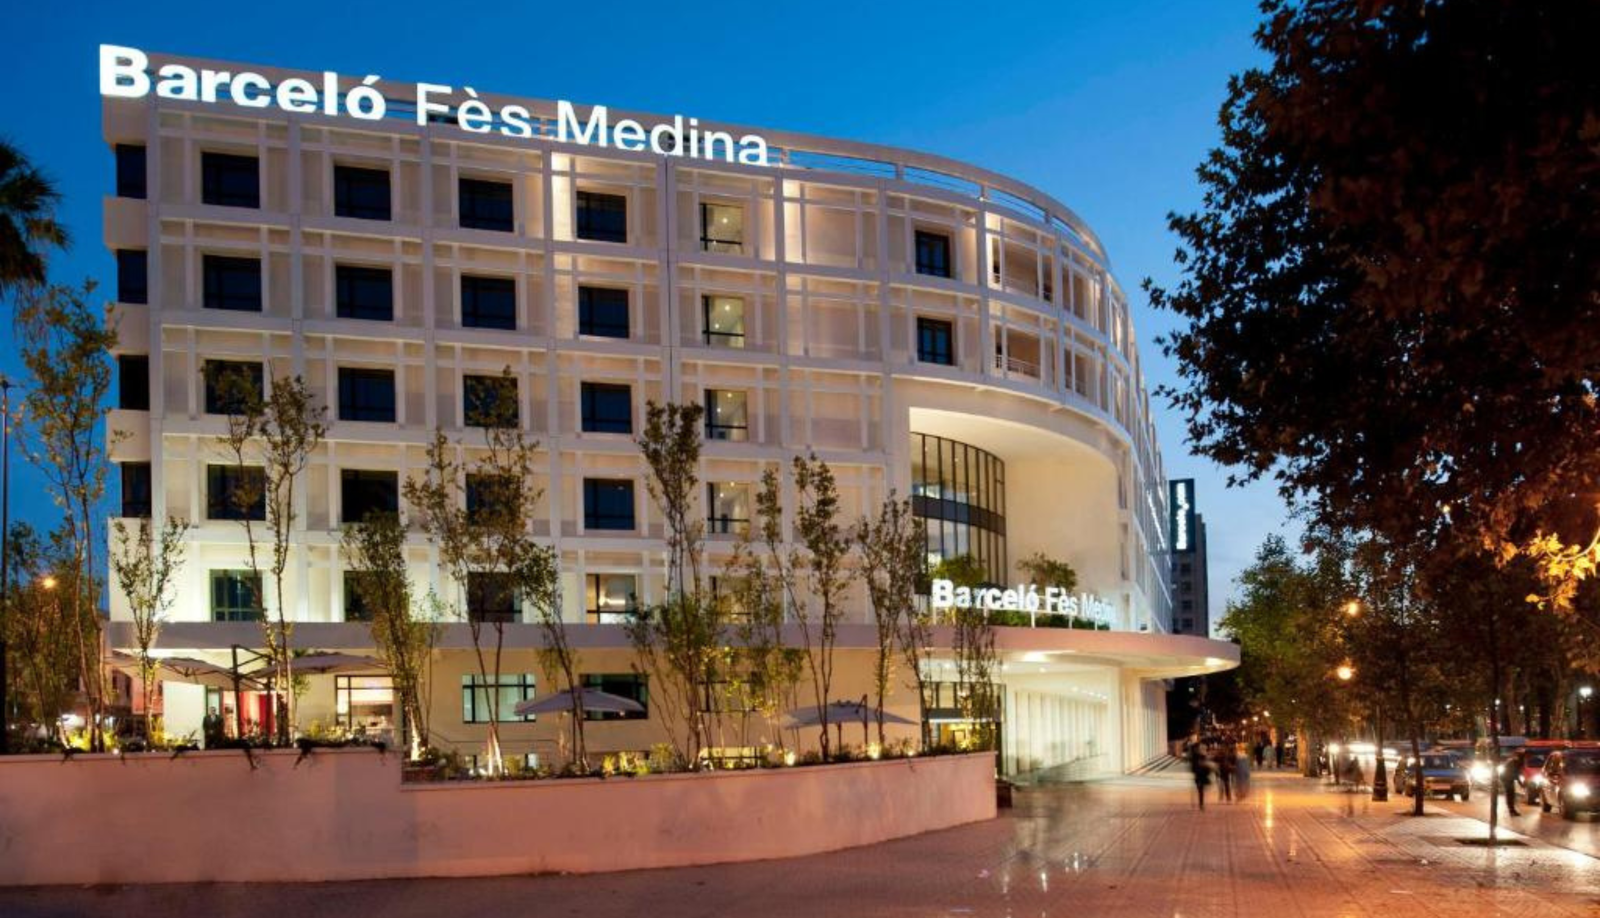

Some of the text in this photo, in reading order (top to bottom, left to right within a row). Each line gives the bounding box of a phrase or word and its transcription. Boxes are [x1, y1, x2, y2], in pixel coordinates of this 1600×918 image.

[99, 44, 769, 167] Barceló Fès Medina
[931, 578, 1040, 611] Barceló
[1044, 586, 1078, 616] Fès
